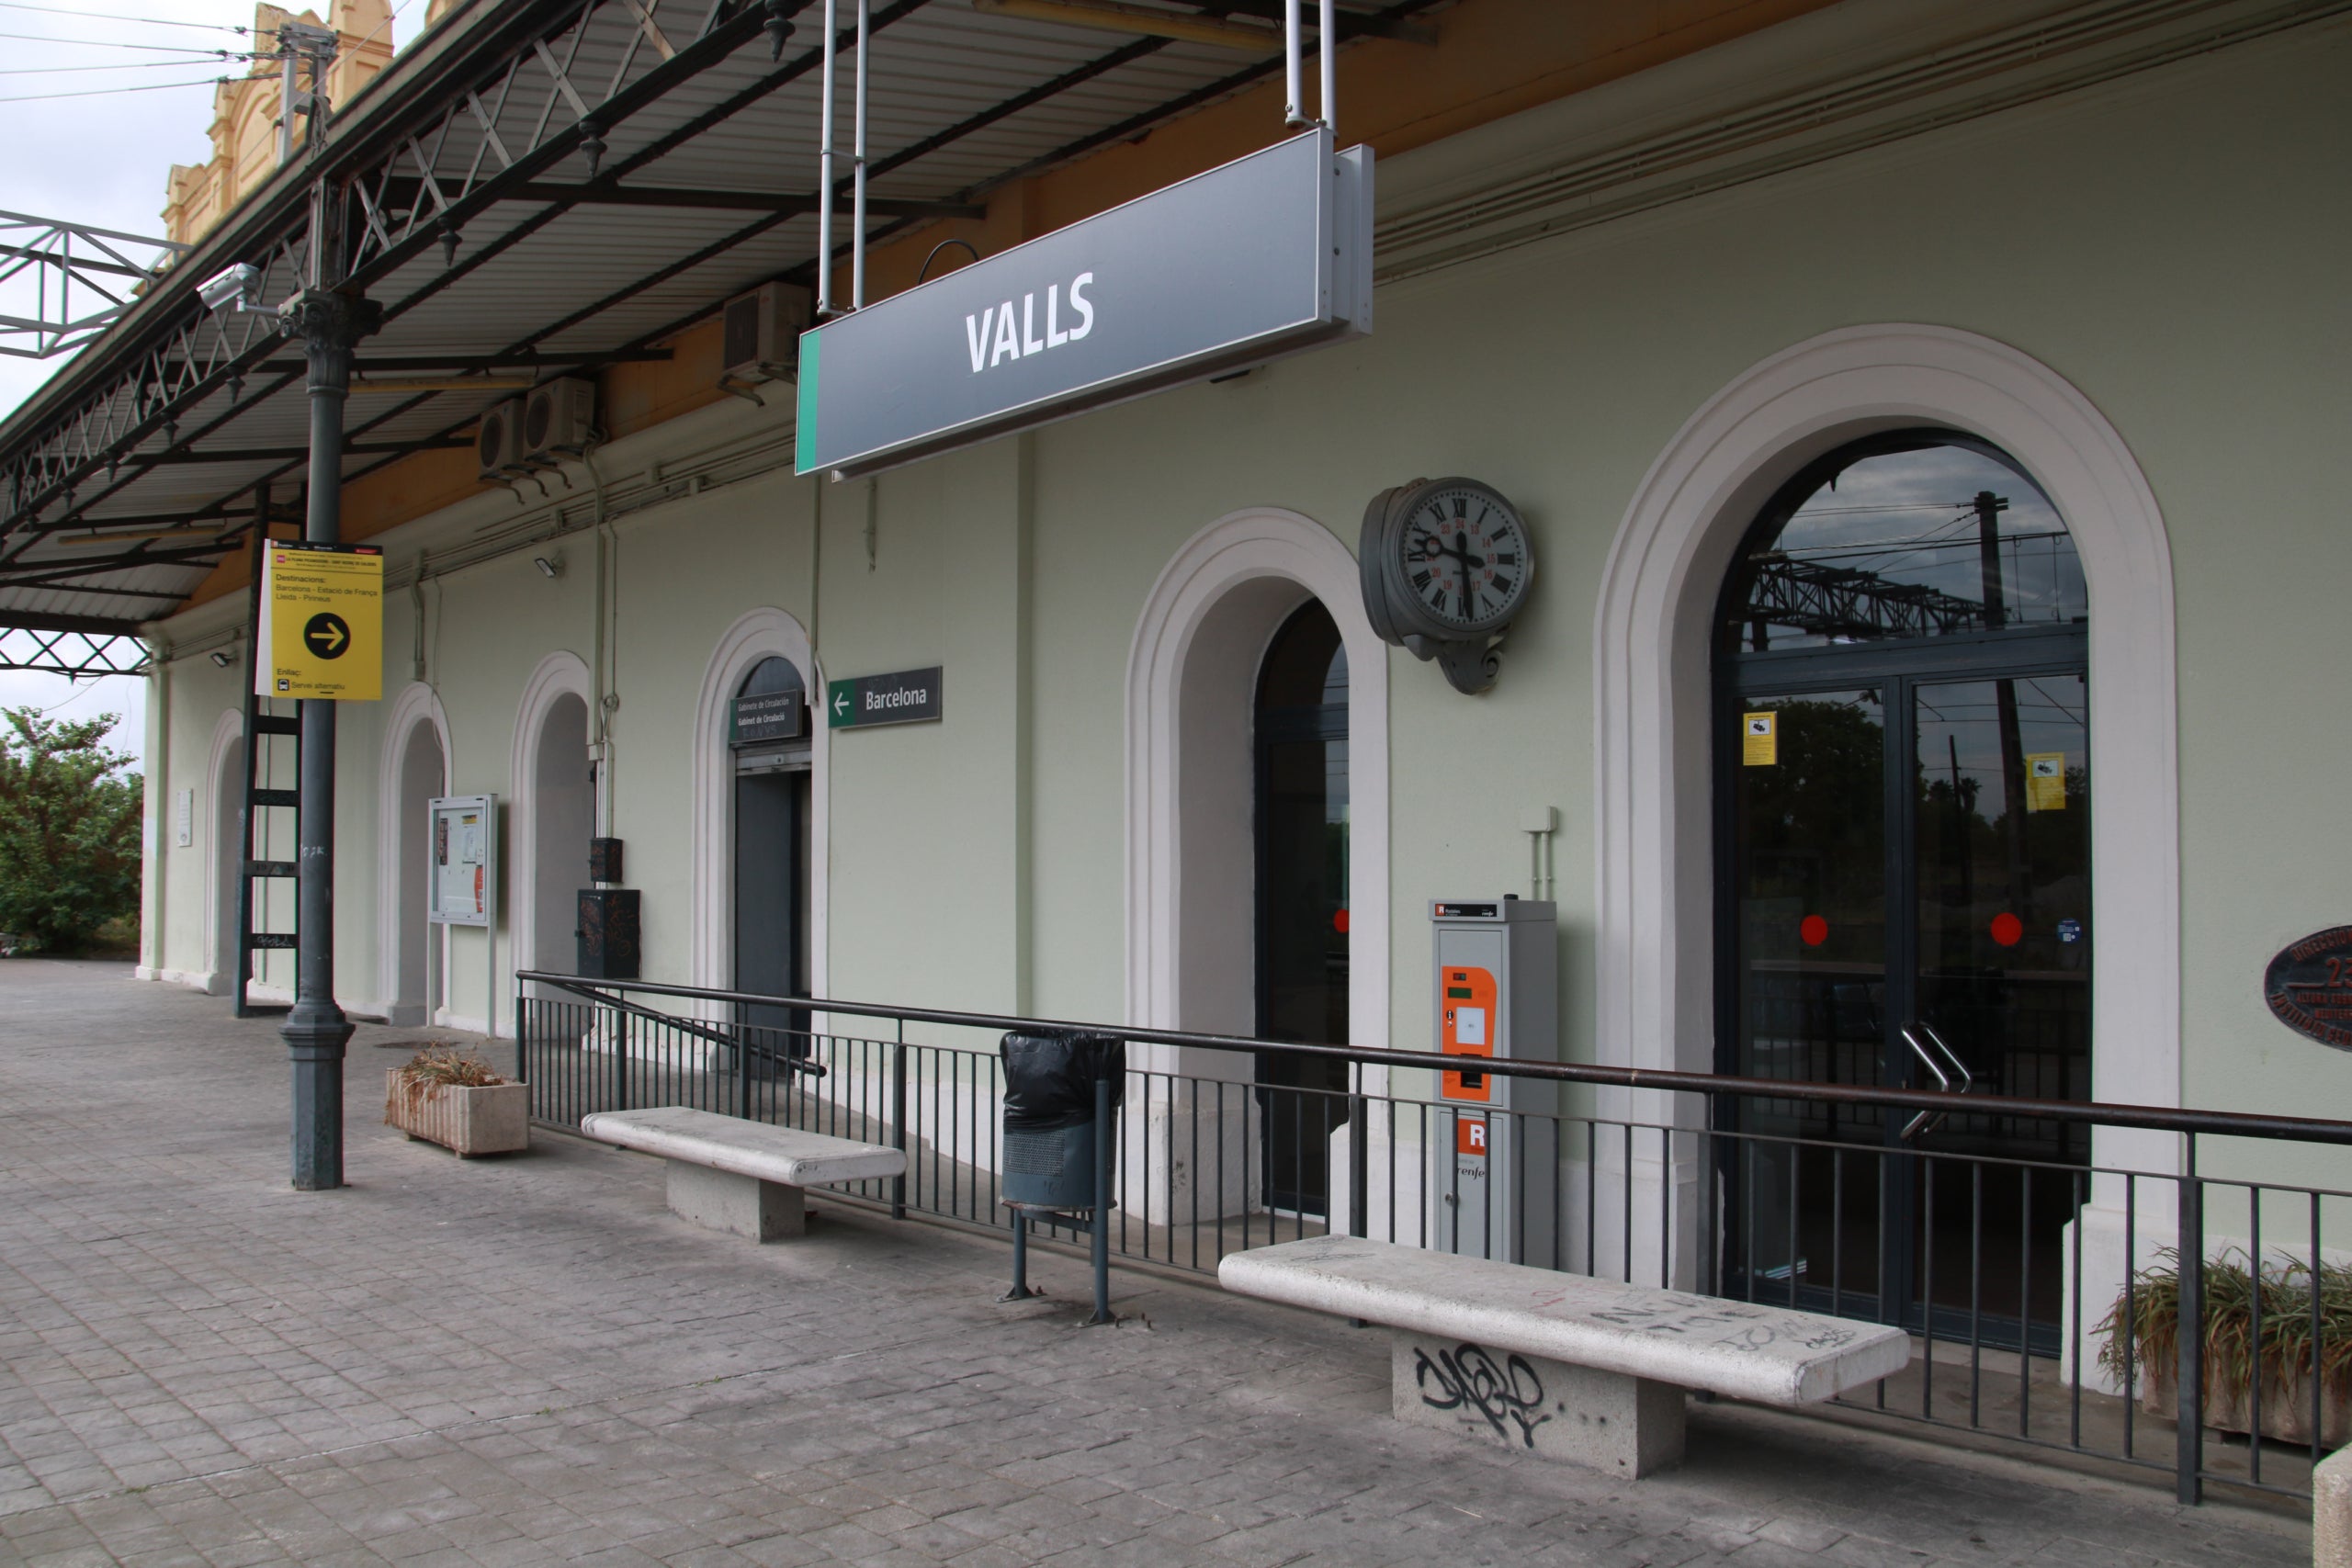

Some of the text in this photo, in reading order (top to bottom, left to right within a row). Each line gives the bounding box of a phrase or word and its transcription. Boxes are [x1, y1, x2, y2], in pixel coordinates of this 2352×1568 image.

[966, 272, 1094, 374] VALLS
[276, 573, 326, 583] Destinacions:
[276, 583, 311, 592] Barcelona
[317, 586, 343, 594] Estació
[355, 588, 378, 597] França
[303, 594, 331, 603] Pirineus
[277, 668, 301, 677] Enllaç:
[738, 696, 789, 712] Gabinete de Circulación
[865, 686, 927, 711] Barcelona
[738, 712, 786, 727] Gabinet de Circulació
[1470, 1124, 1486, 1147] R
[1456, 1167, 1486, 1179] renfe
